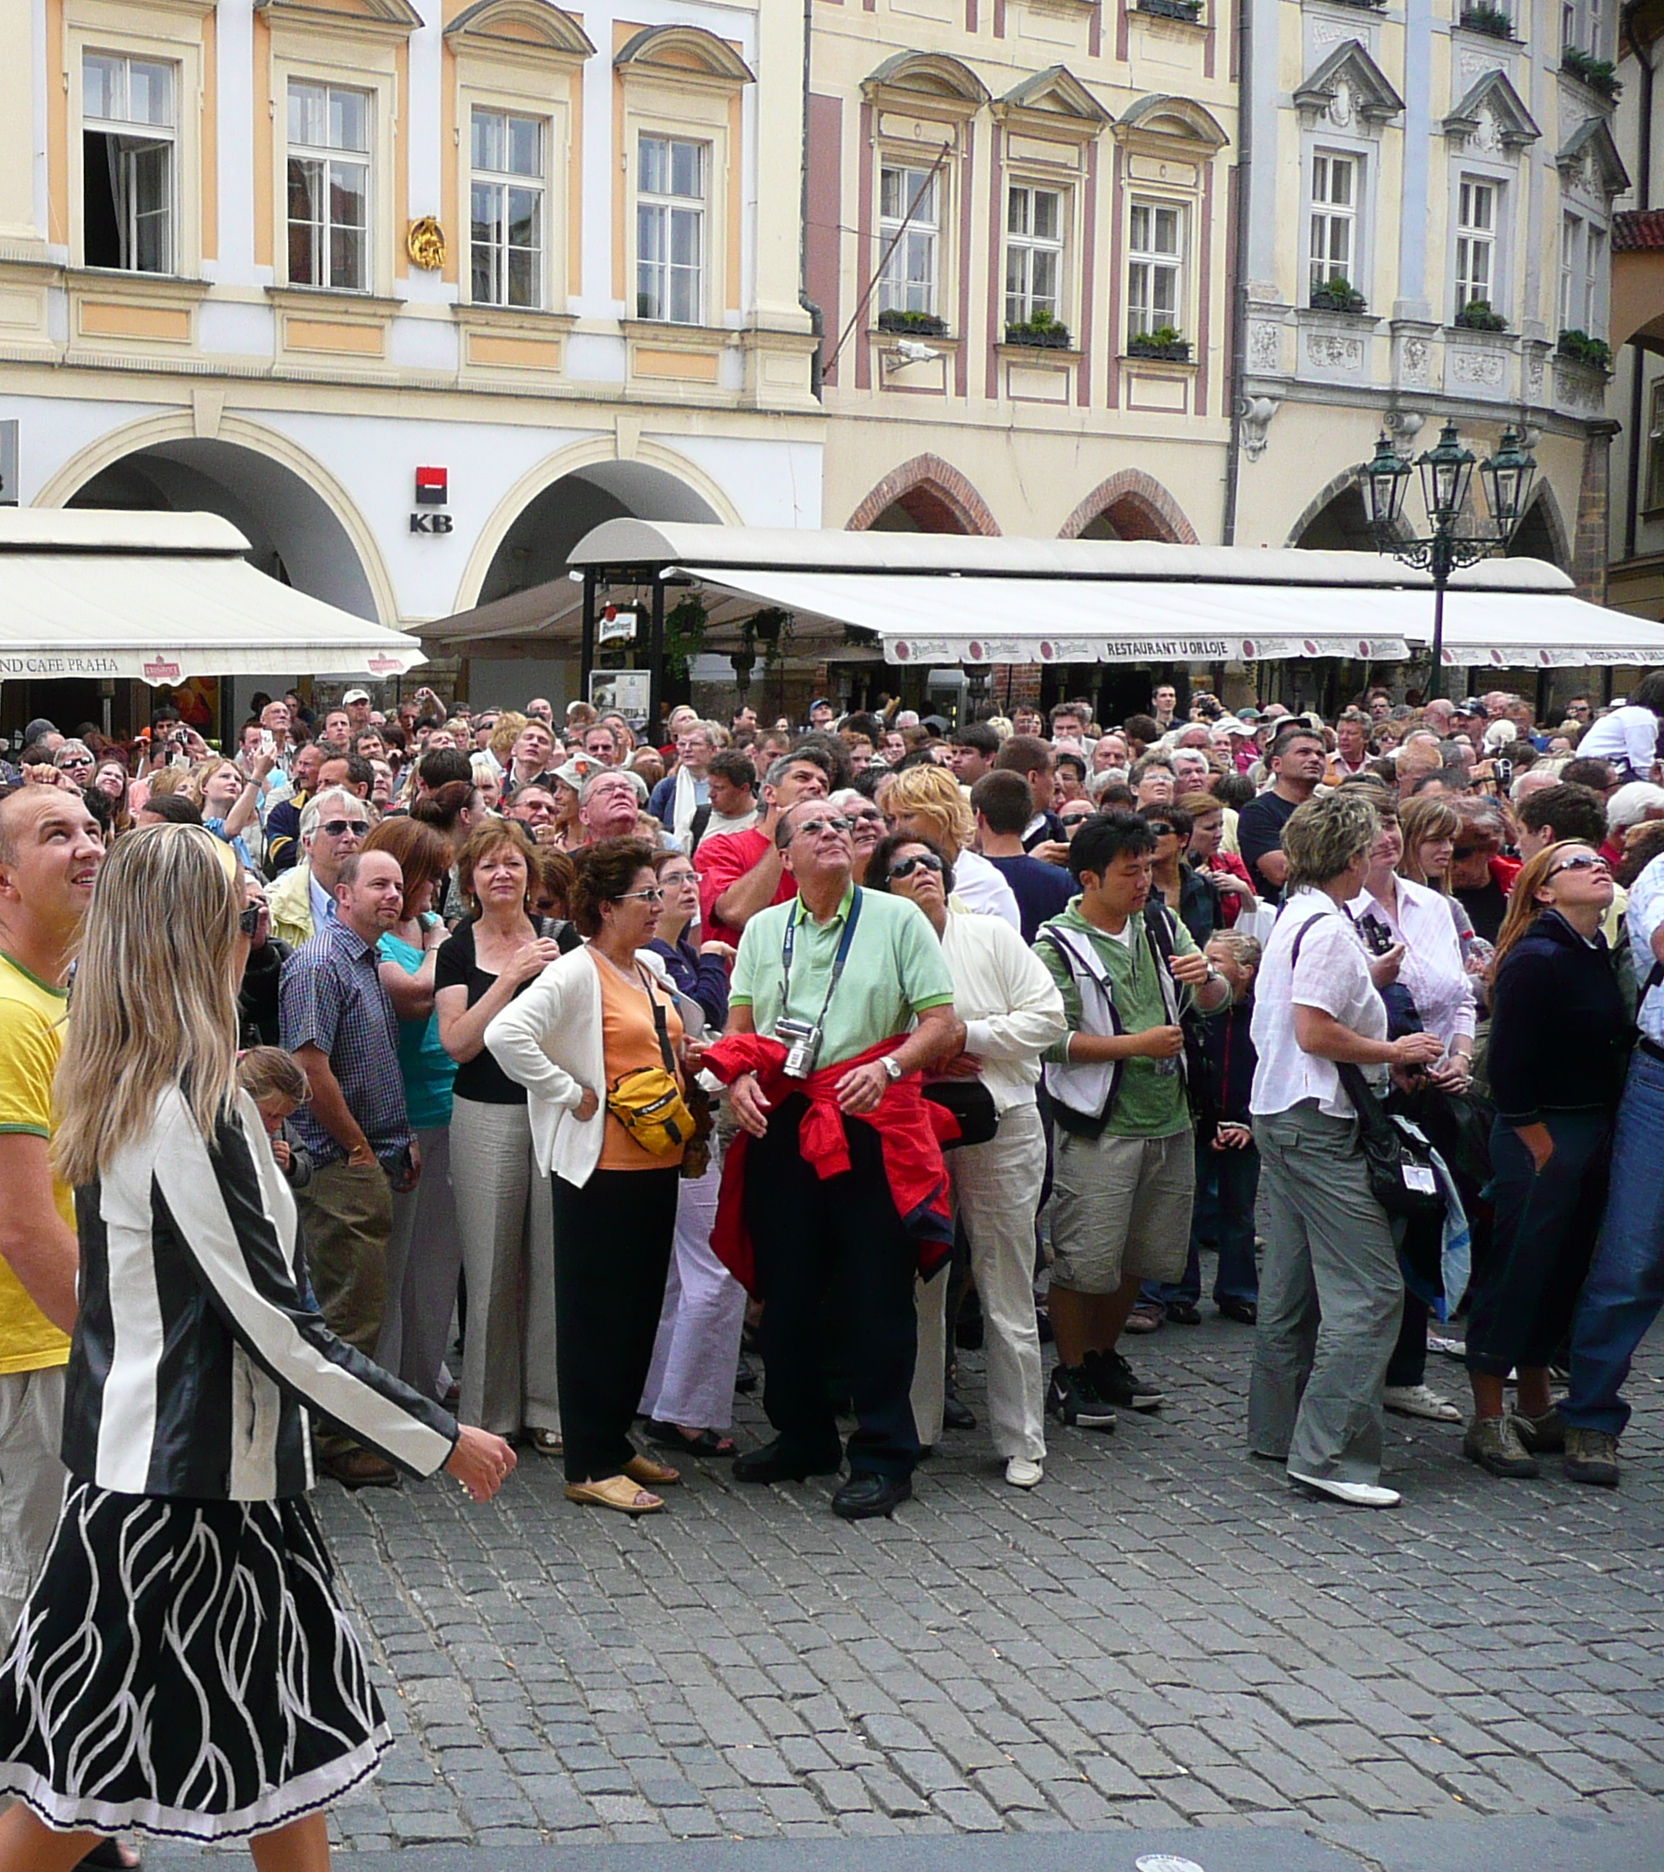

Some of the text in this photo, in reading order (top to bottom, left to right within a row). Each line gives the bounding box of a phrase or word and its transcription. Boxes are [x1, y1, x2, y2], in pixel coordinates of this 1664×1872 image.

[409, 513, 454, 534] KB
[1107, 641, 1229, 657] RESTAURANT U ORLOJE
[26, 658, 65, 673] CAFE
[67, 657, 119, 673] PRAHA
